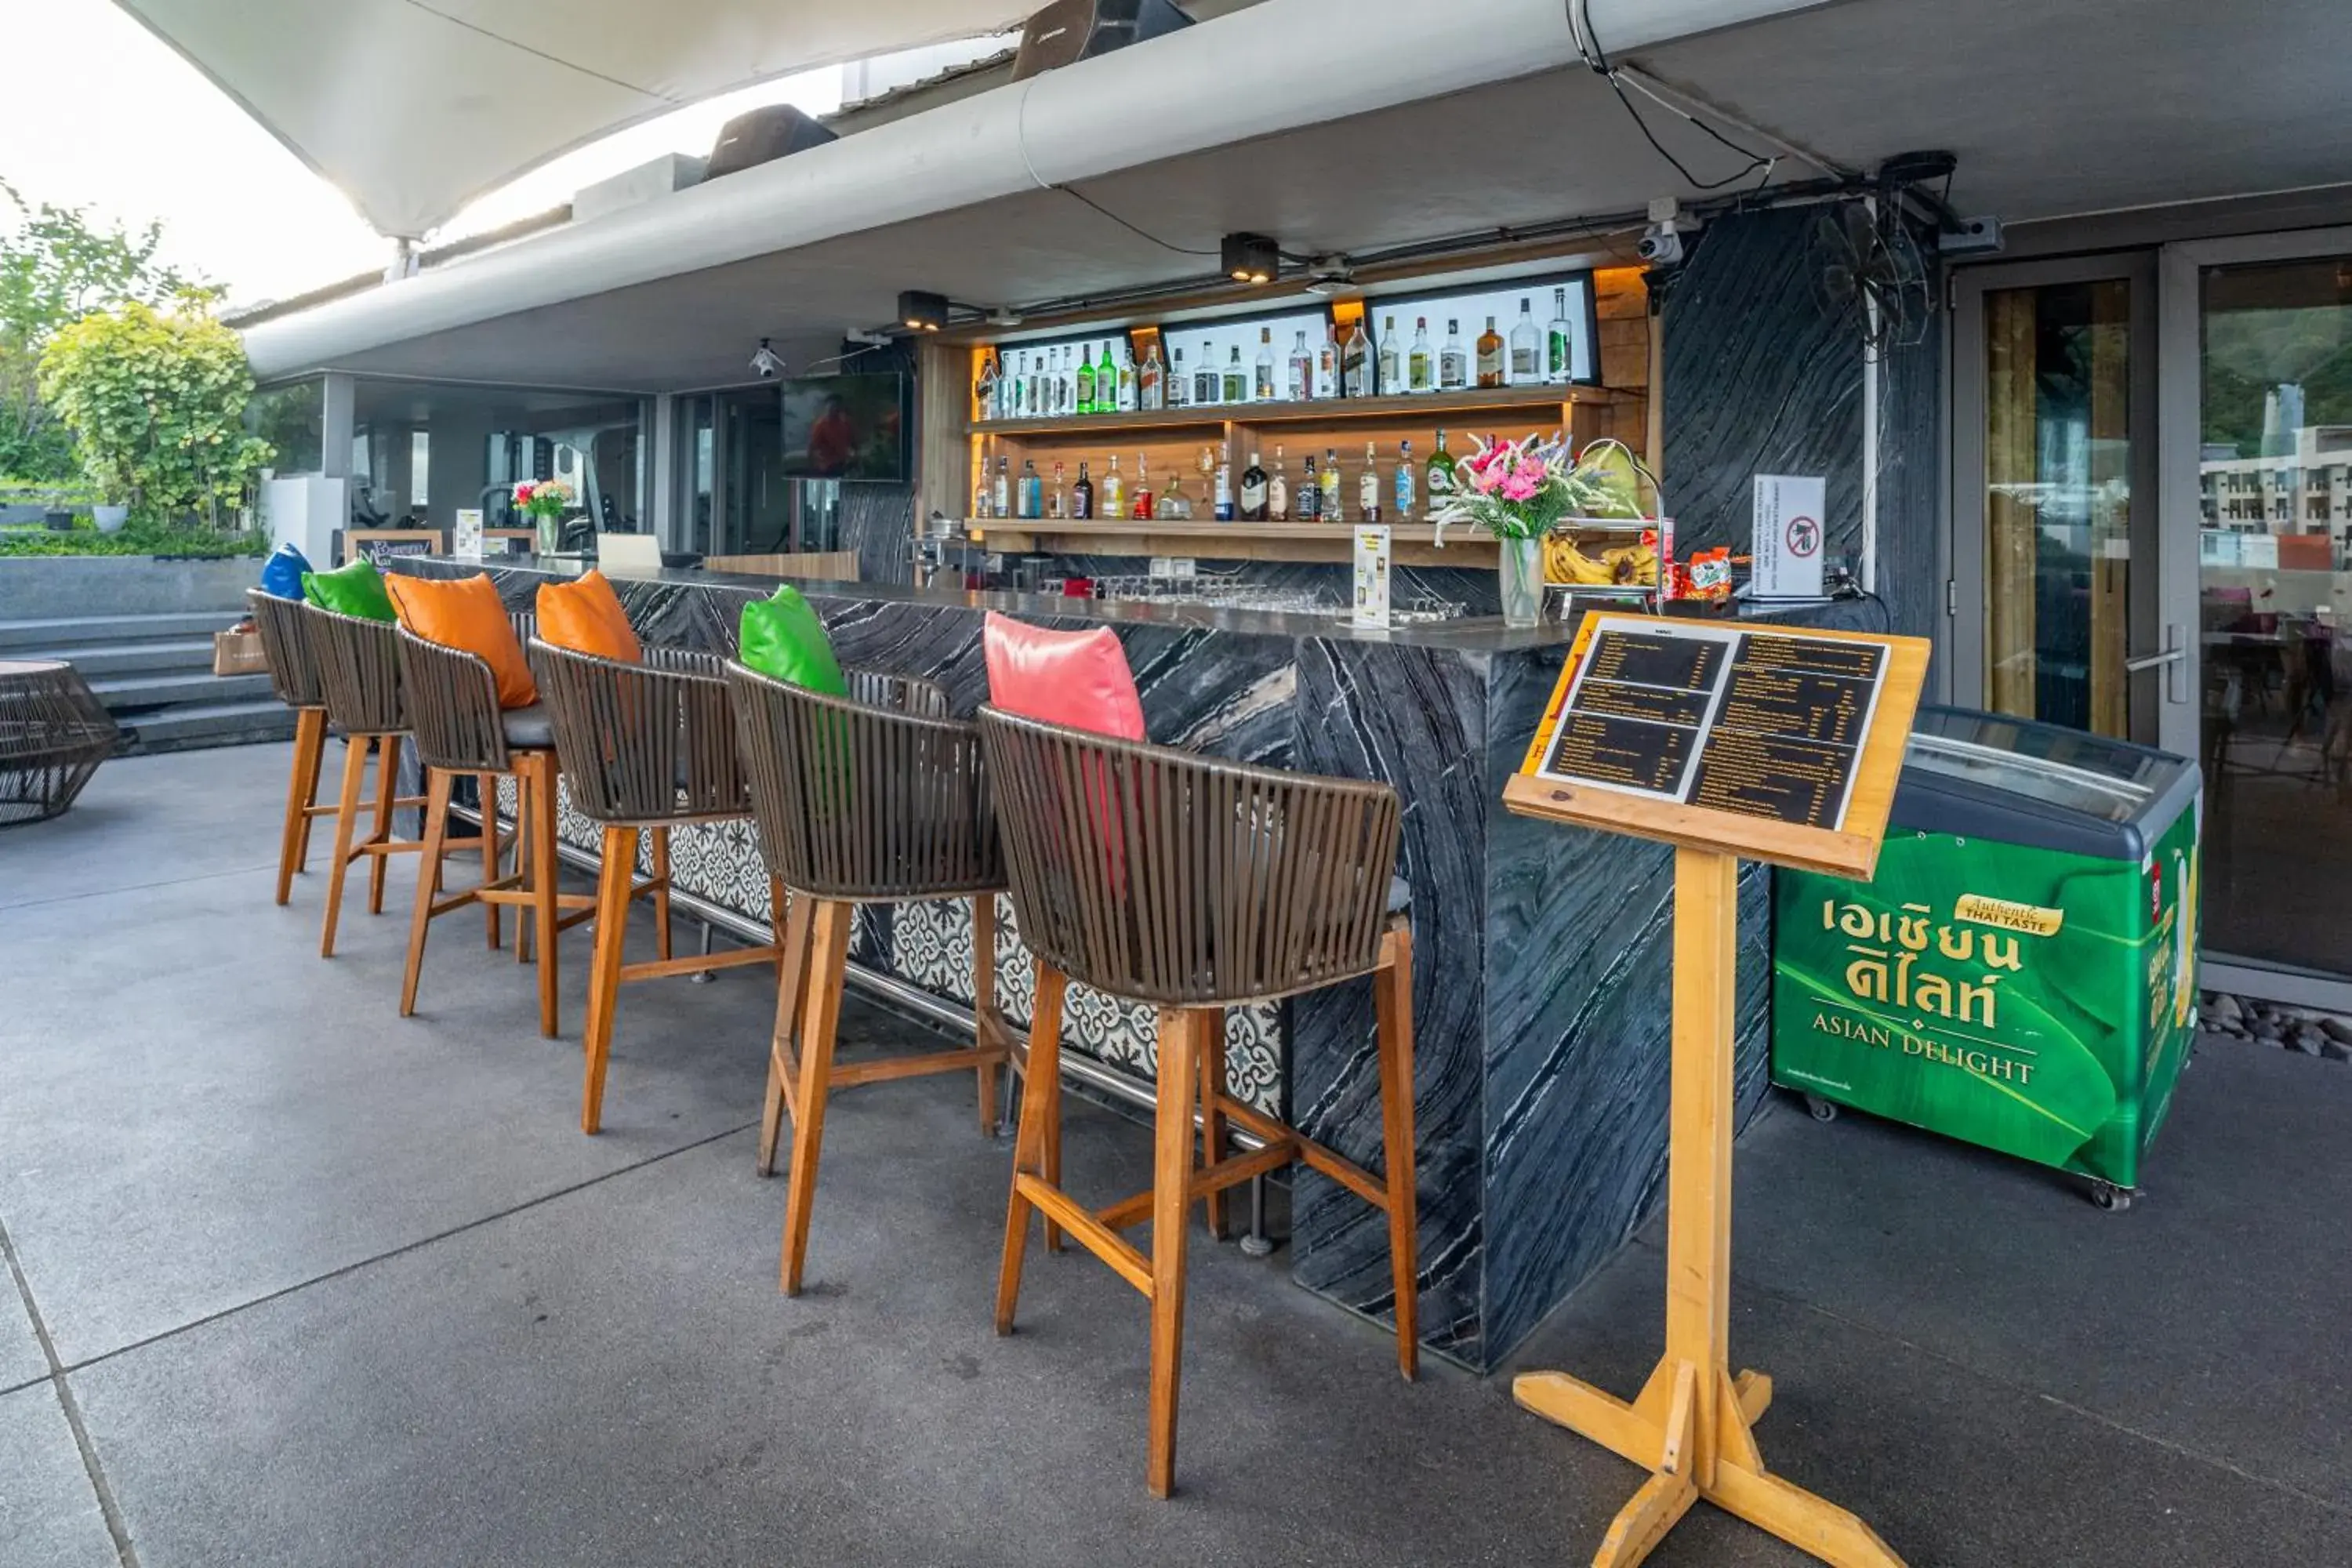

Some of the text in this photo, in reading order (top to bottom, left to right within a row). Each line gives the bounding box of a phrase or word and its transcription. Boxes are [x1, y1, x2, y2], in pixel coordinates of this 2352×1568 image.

[1965, 909, 2047, 932] THAI TASTE
[1969, 898, 2038, 920] Authentic
[1813, 1012, 1890, 1048] ASIAN
[1902, 1034, 2034, 1084] DELIGHT
